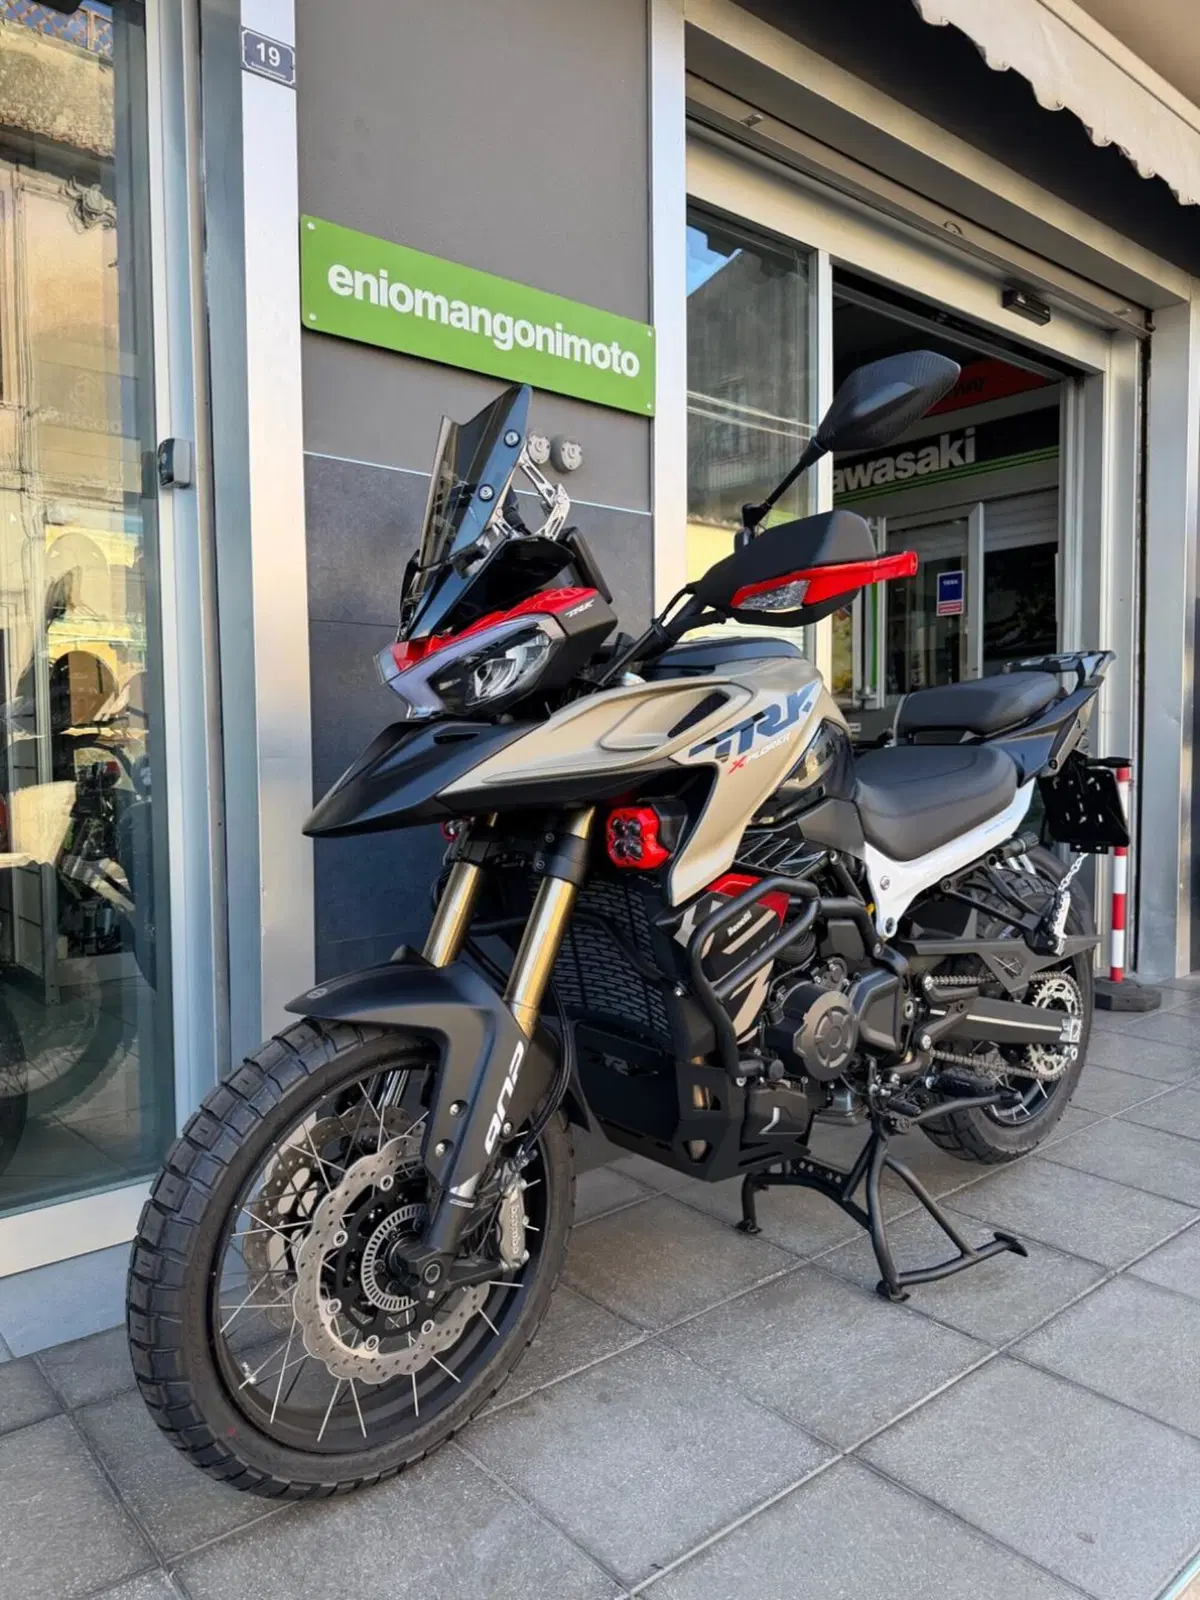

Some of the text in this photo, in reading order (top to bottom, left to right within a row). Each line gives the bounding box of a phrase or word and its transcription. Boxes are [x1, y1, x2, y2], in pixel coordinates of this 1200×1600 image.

[256, 42, 281, 67] 19
[327, 263, 641, 378] eniomangonimoto
[832, 427, 976, 493] awasaki
[688, 680, 819, 760] TRK
